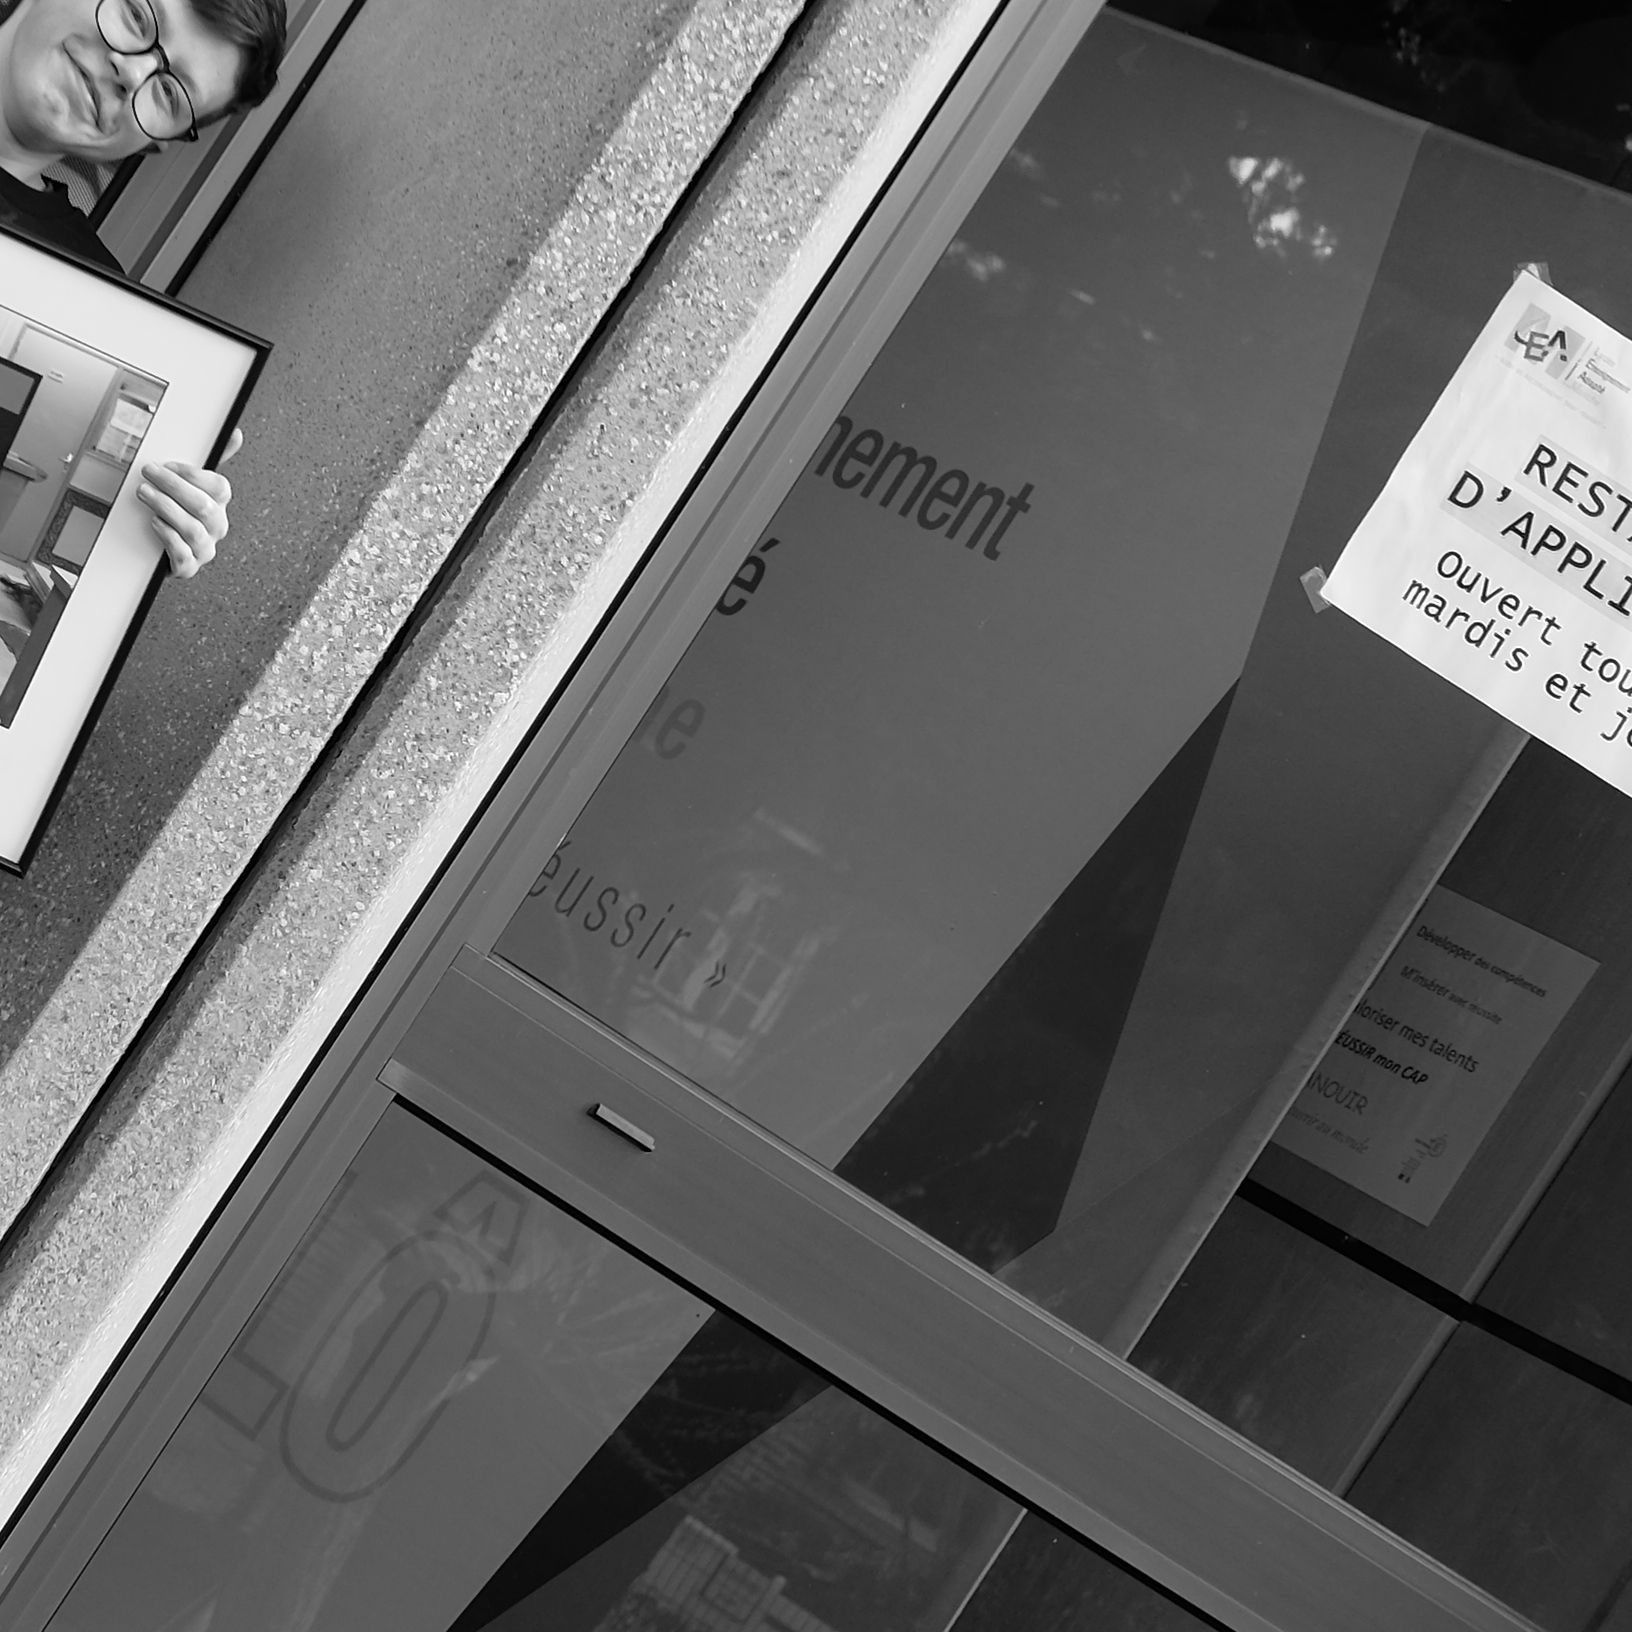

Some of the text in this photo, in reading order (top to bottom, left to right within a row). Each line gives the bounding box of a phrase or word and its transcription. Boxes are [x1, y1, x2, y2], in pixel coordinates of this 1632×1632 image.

[1523, 442, 1632, 541] REST
[1436, 550, 1562, 647] Ouvert
[1401, 579, 1530, 672] mardis
[1544, 673, 1592, 714] et
[1416, 924, 1477, 962] Développer
[1372, 1053, 1402, 1075] mon
[1400, 1065, 1430, 1086] CAP
[1398, 1024, 1431, 1048] mes
[1428, 1037, 1480, 1074] talents
